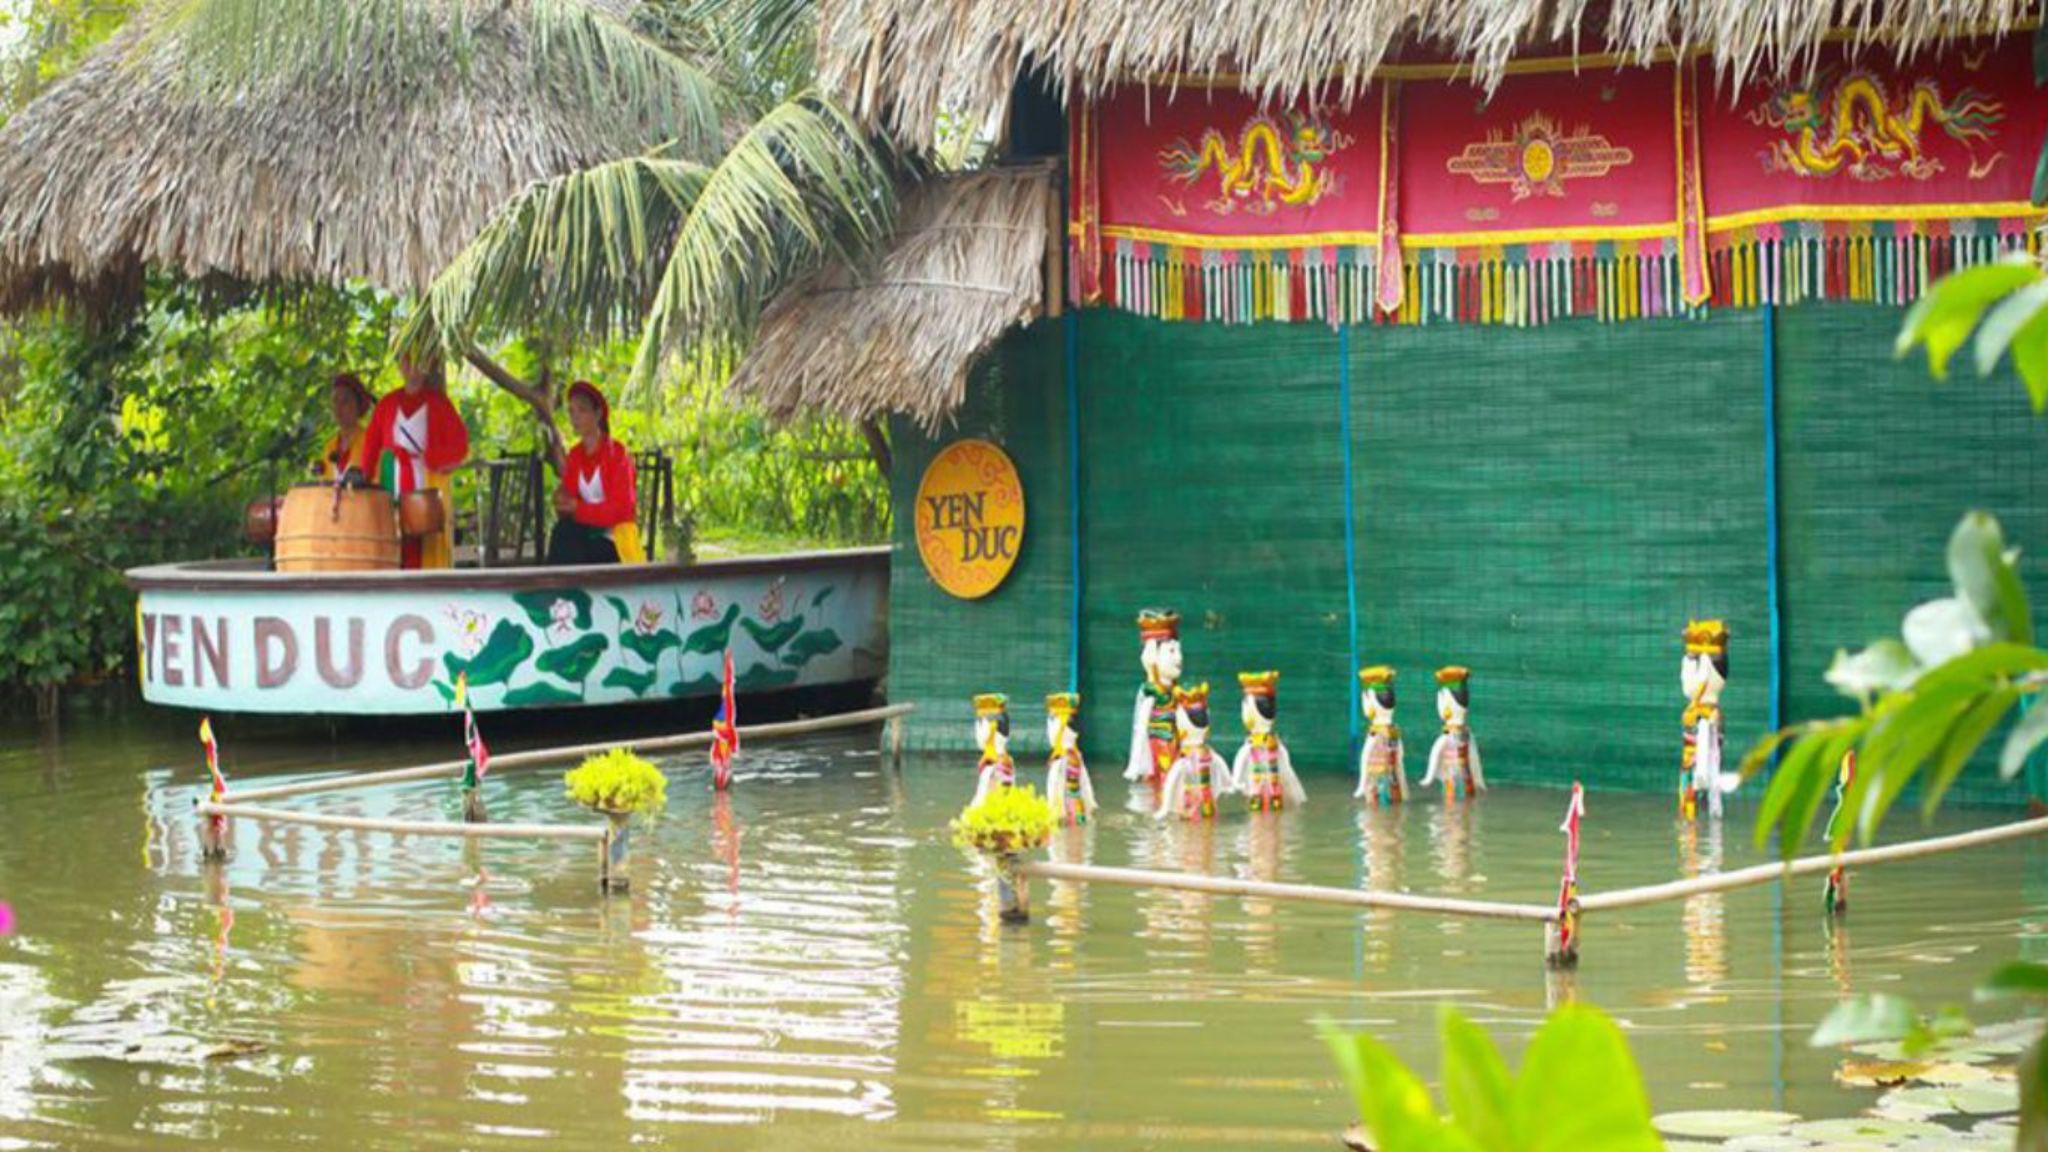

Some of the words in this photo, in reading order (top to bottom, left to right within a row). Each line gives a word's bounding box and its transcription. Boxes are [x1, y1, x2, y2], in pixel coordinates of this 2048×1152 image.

[926, 491, 986, 529] YEN
[962, 525, 1017, 562] DUC
[142, 612, 229, 689] YEN
[253, 613, 435, 689] DUC
